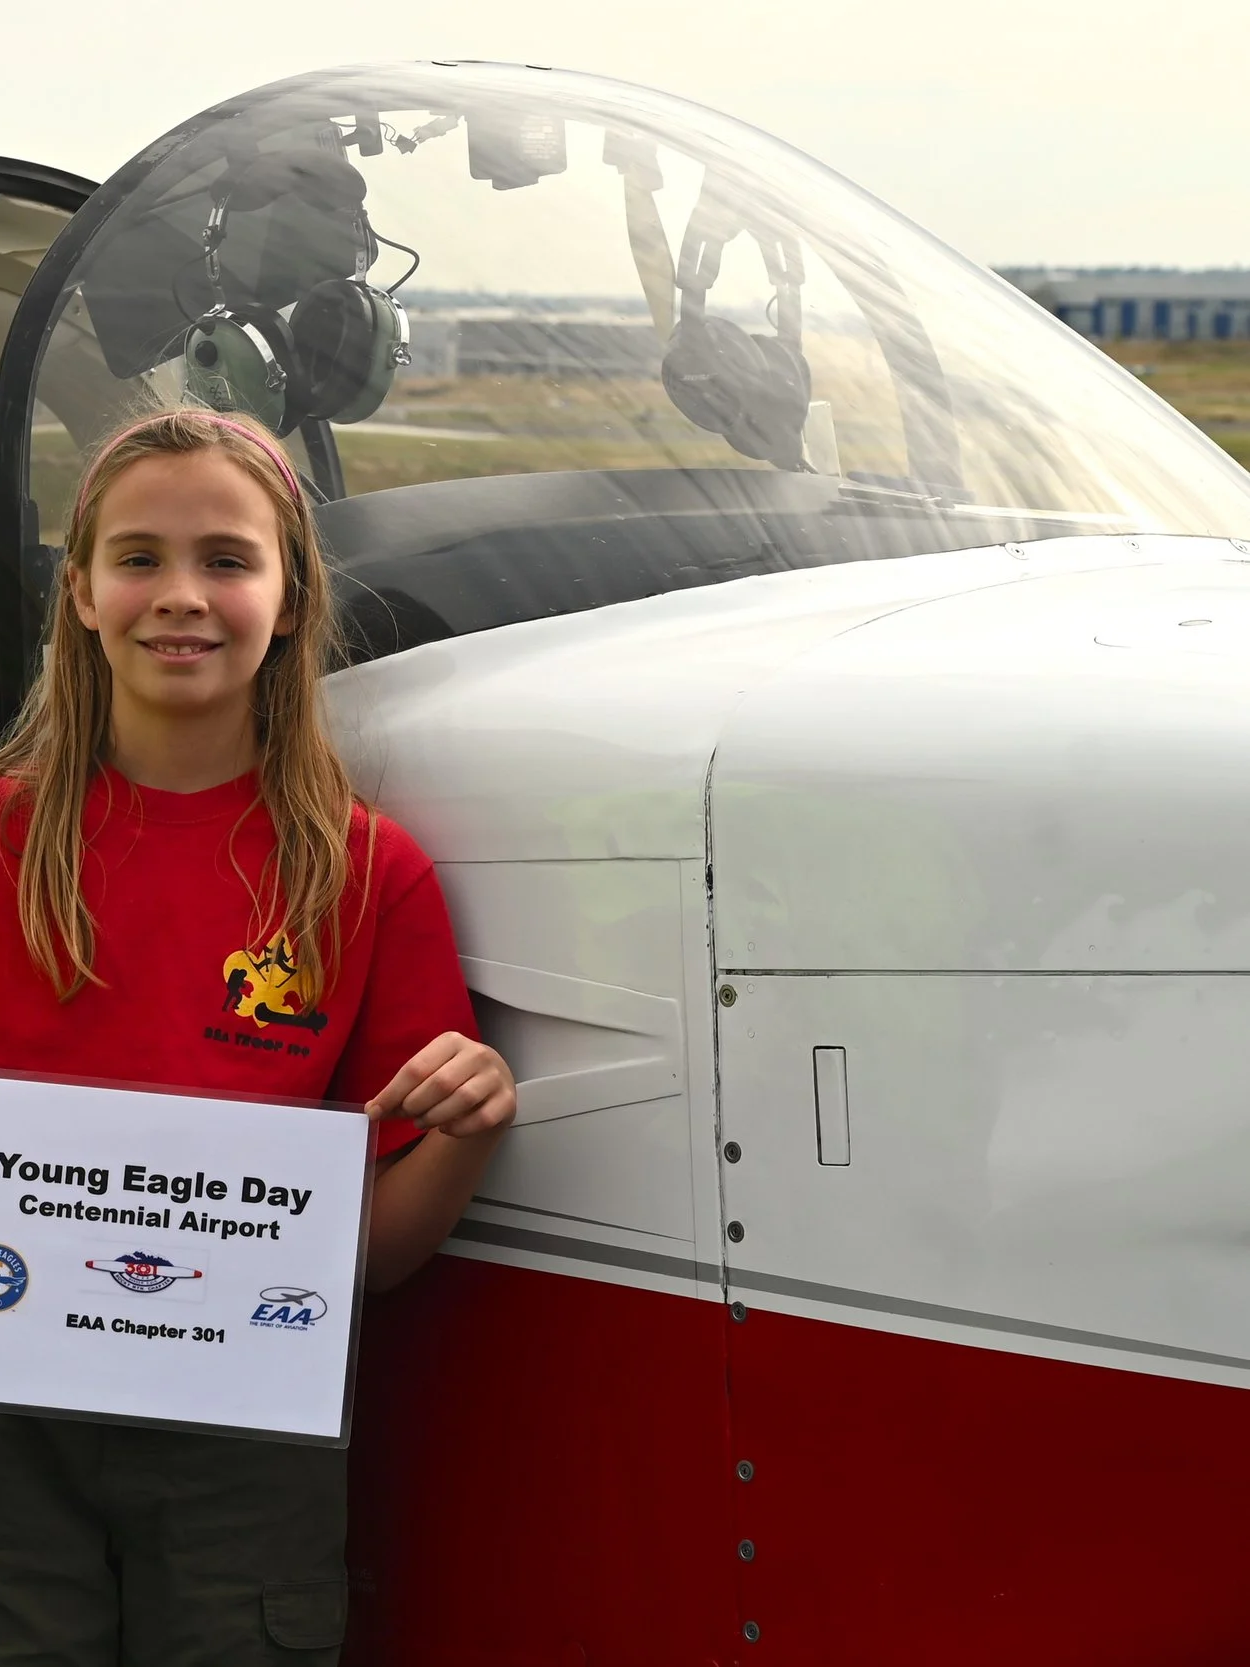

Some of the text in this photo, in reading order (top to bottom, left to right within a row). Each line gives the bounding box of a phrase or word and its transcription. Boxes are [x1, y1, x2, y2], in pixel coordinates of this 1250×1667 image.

[123, 1164, 228, 1204] Eagle
[241, 1176, 313, 1216] Day
[19, 1194, 281, 1240] Centennial Airport
[124, 1262, 158, 1277] 301
[66, 1313, 225, 1343] EAA Chapter 301
[251, 1303, 312, 1326] EAA
